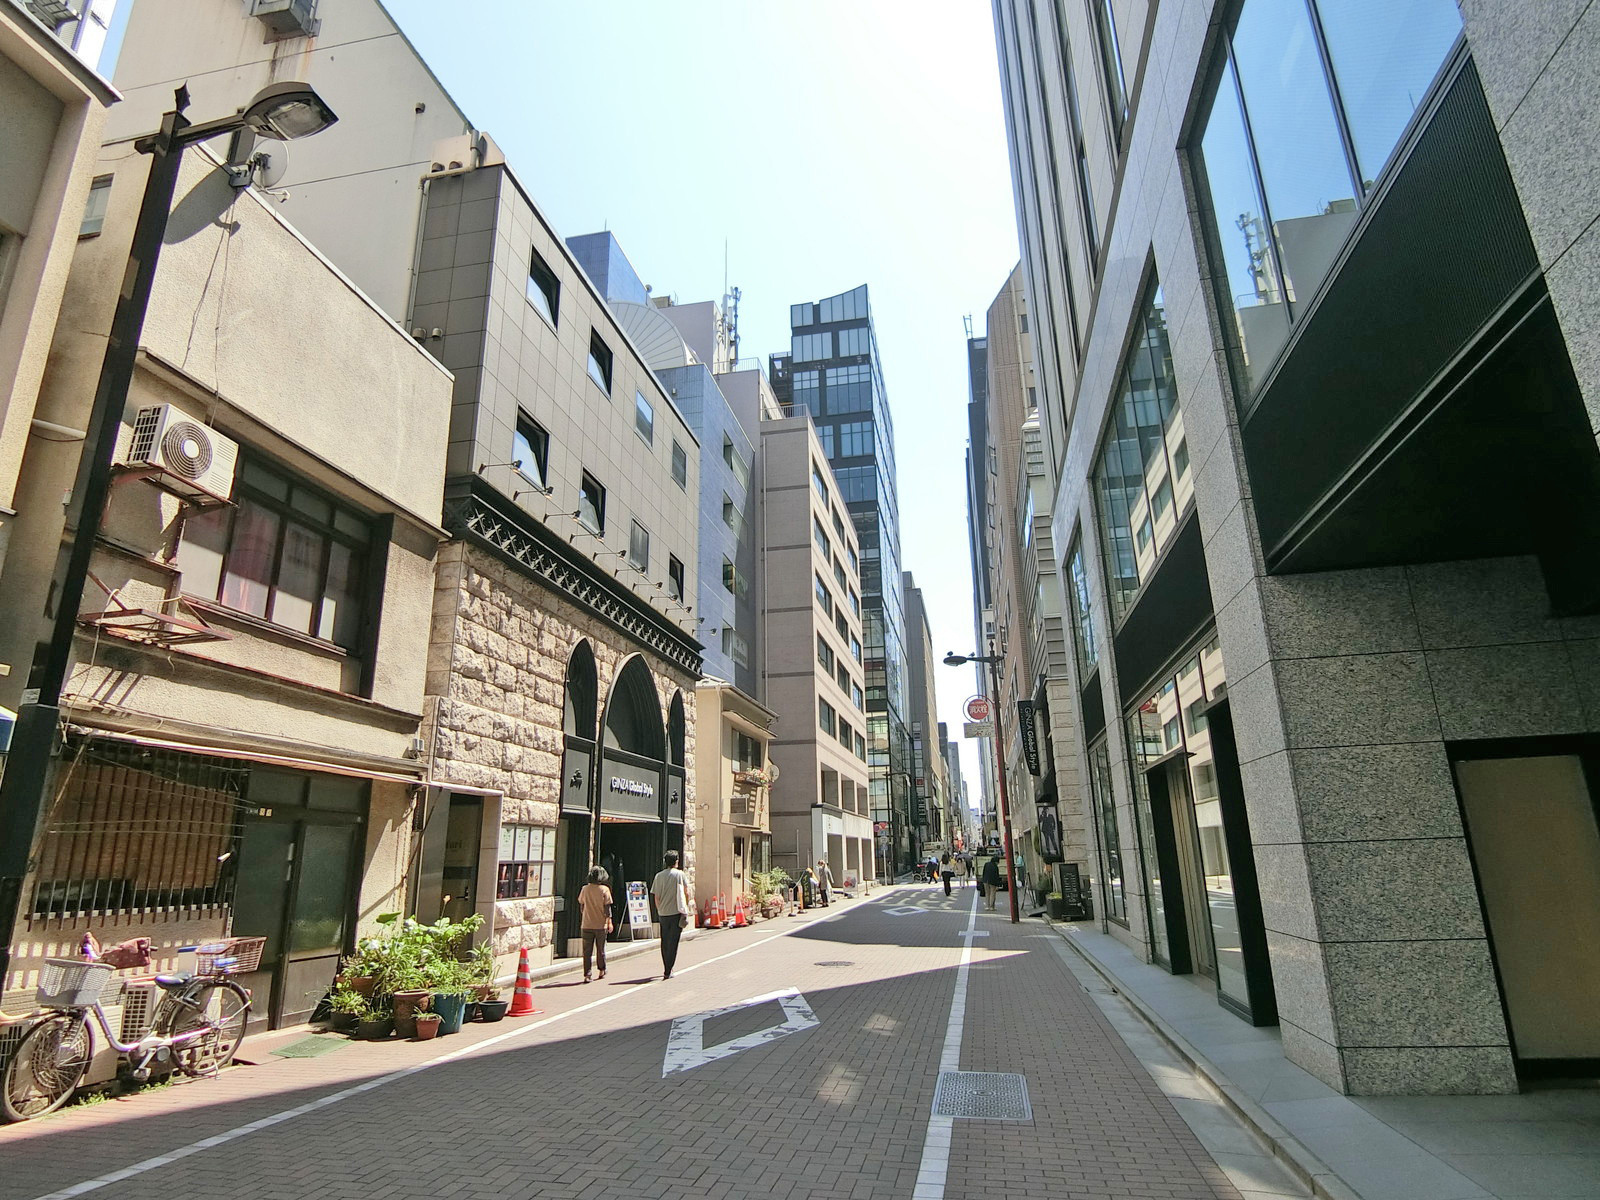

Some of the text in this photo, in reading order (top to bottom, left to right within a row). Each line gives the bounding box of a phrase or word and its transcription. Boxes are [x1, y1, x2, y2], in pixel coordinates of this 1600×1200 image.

[969, 705, 988, 714] 消火栓
[1024, 707, 1033, 730] GINZA
[1027, 730, 1035, 753] Global
[1029, 753, 1037, 770] Style
[611, 776, 653, 797] GINZA Global Style
